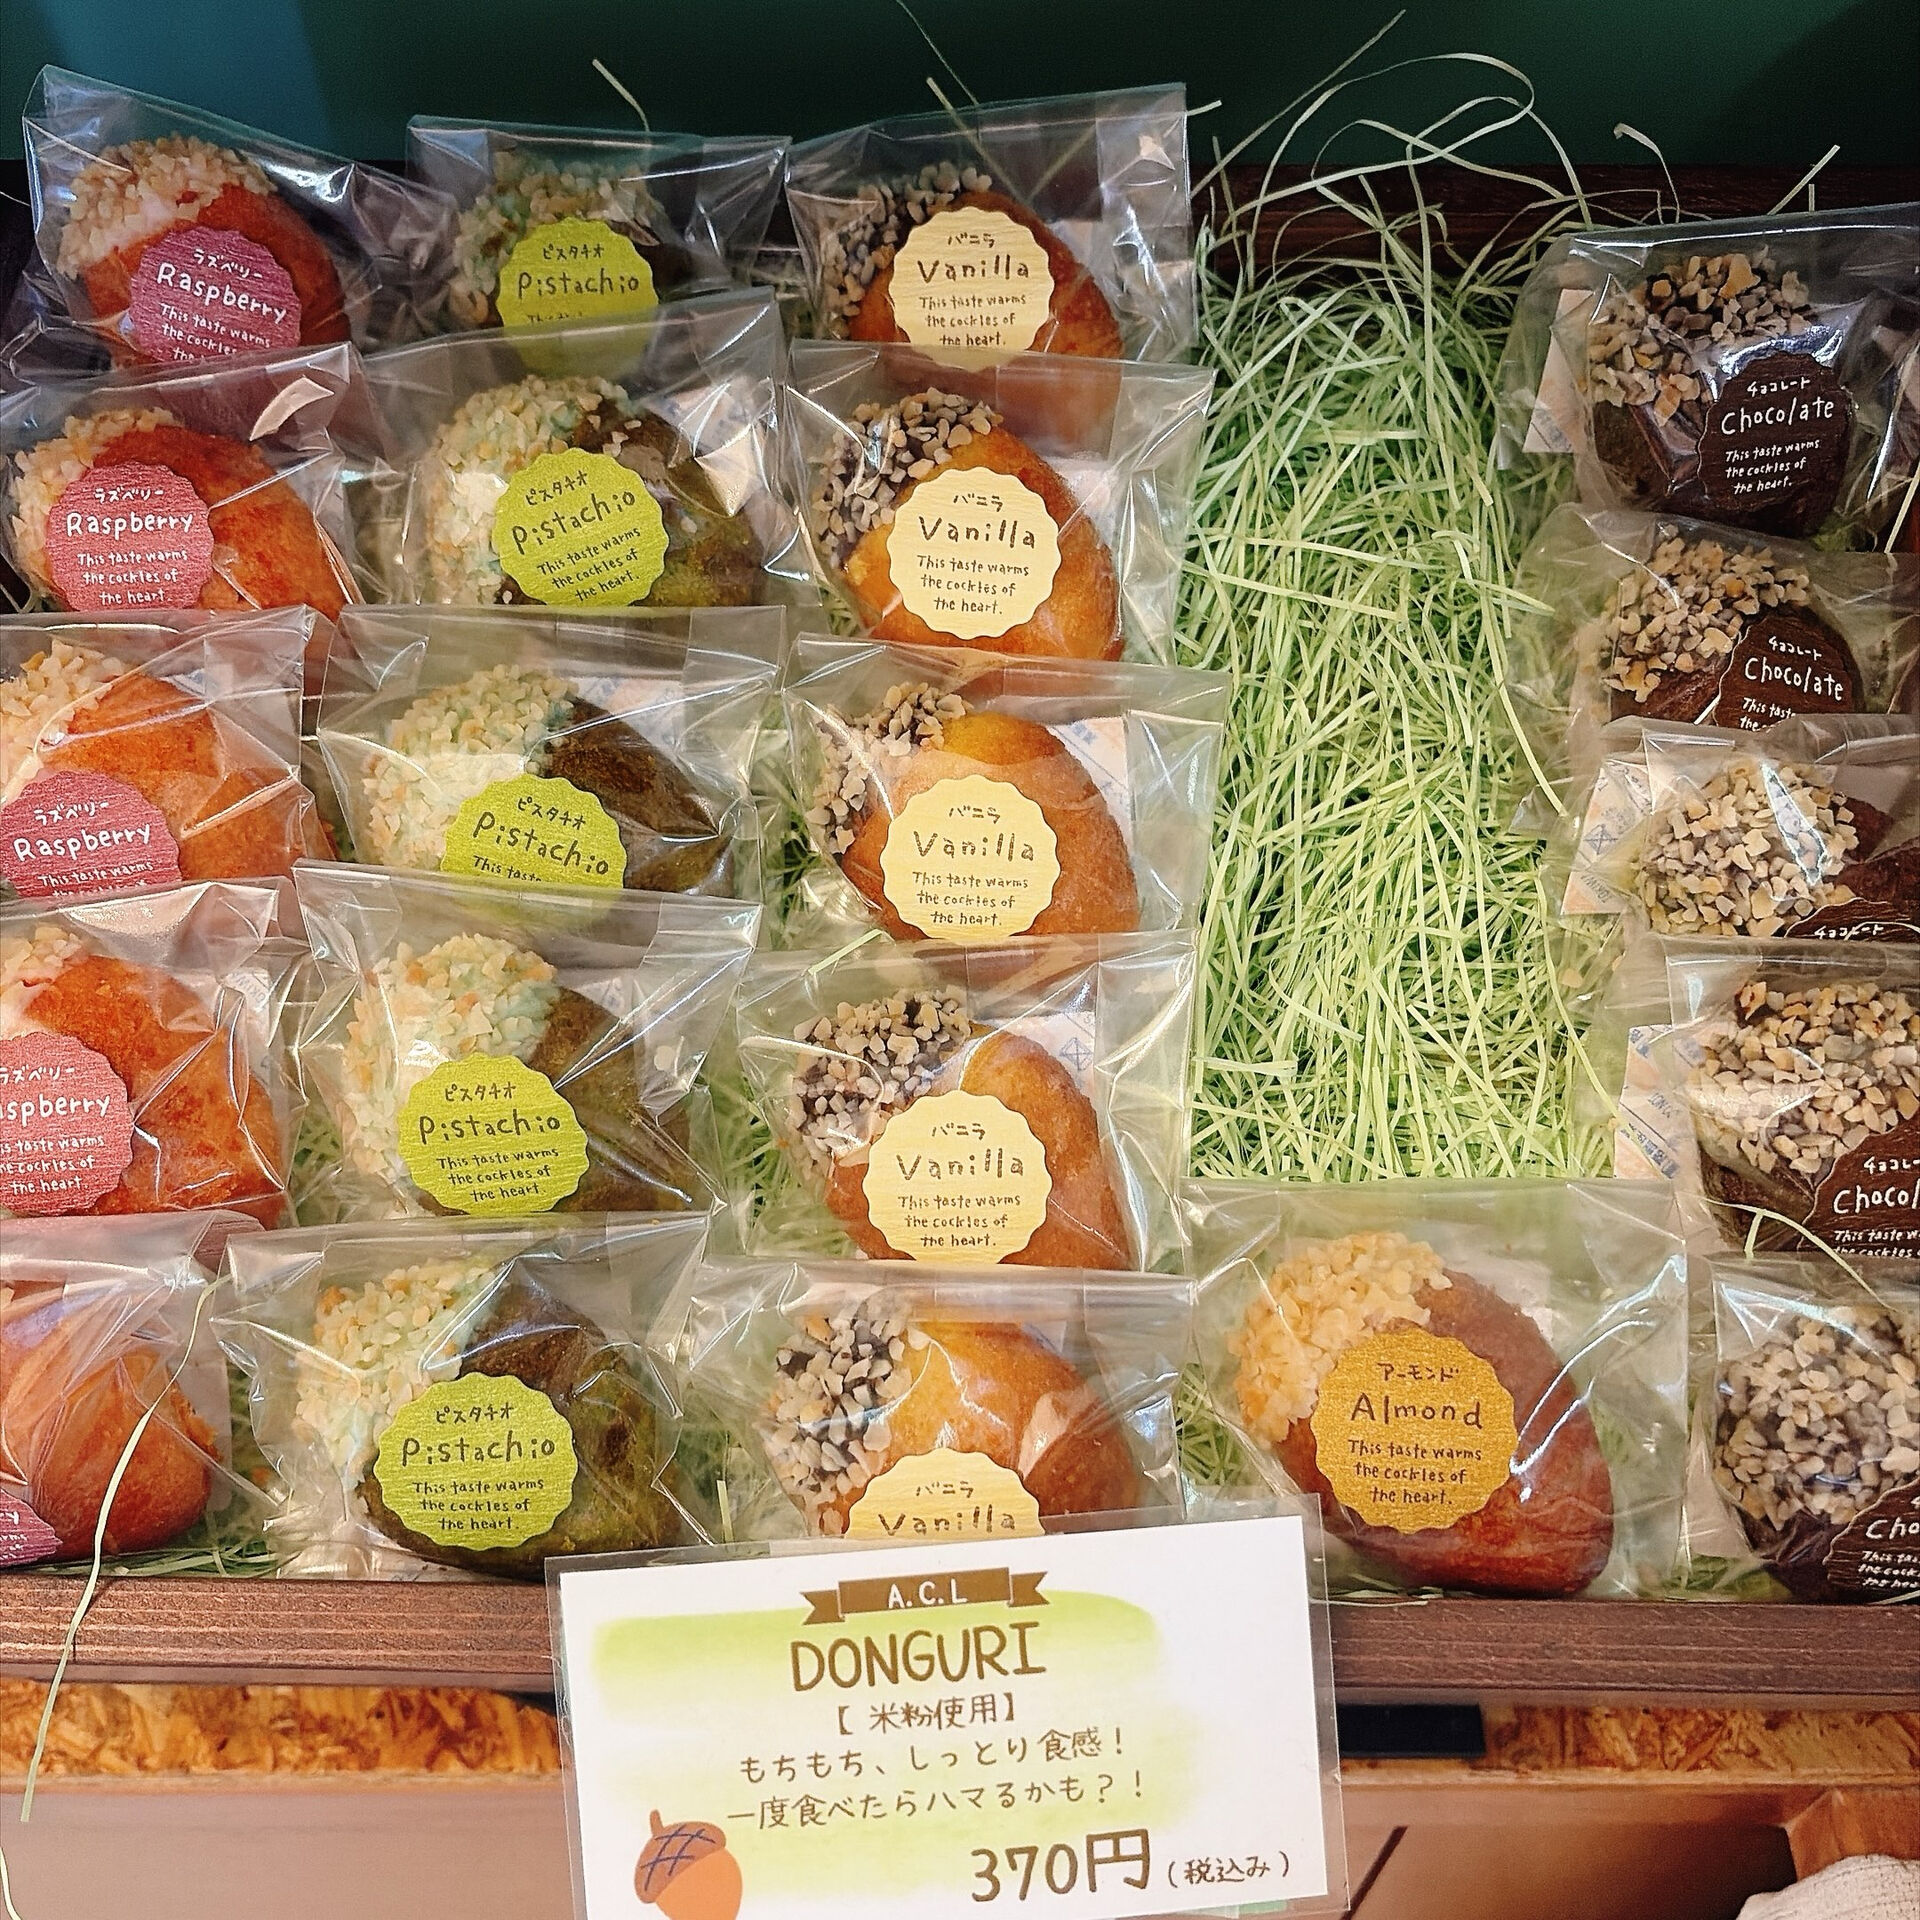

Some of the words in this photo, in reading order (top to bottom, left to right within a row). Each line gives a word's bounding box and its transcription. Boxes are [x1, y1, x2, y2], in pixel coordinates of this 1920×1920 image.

[948, 232, 995, 247] バニラ
[543, 243, 604, 260] ピスタチオ
[194, 249, 262, 279] ラズベリー
[917, 254, 1028, 283] Vanilla
[157, 263, 286, 324] Raspberry
[919, 296, 946, 310] This
[951, 296, 982, 308] taste
[987, 295, 1026, 305] warms
[160, 302, 188, 323] This
[192, 314, 226, 335] taste
[231, 328, 270, 348] warms
[926, 315, 945, 327] the
[950, 314, 998, 326] cockles
[1003, 313, 1016, 325] of
[162, 324, 184, 340] the
[940, 334, 960, 345] the
[1747, 377, 1811, 397] チョコレート
[1722, 397, 1834, 435] Chocolate
[1725, 452, 1749, 462] This
[1753, 445, 1782, 459] taste
[1785, 440, 1820, 453] warms
[1725, 467, 1744, 478] the
[1747, 461, 1790, 476] cockles
[1794, 457, 1806, 469] of
[94, 486, 164, 504] ラズベリー
[525, 470, 588, 506] ピスタチオ
[1734, 483, 1752, 495] the
[954, 493, 1003, 512] バニラ
[66, 512, 193, 540] Raspberry
[919, 516, 1035, 549] Vanilla
[77, 553, 104, 567] This
[109, 551, 142, 565] taste
[146, 550, 188, 562] warms
[537, 560, 565, 575] This
[567, 545, 599, 565] taste
[602, 528, 641, 550] warms
[552, 575, 574, 589] the
[577, 558, 623, 581] cockles
[626, 548, 638, 561] of
[917, 555, 945, 569] This
[950, 558, 983, 572] taste
[988, 563, 1029, 576] warms
[83, 572, 104, 584] the
[109, 570, 160, 584] cockles
[164, 568, 178, 583] of
[921, 574, 941, 589] the
[947, 580, 997, 594] cockles
[1002, 583, 1016, 596] of
[100, 592, 122, 605] the
[575, 586, 596, 601] the
[934, 597, 955, 610] the
[1768, 636, 1822, 661] チョコレート
[1745, 657, 1843, 701] Chocolate
[1743, 697, 1766, 713] This
[1740, 716, 1759, 731] the
[34, 801, 109, 825] ラズベリー
[517, 797, 586, 830] ピスタチオ
[949, 806, 1000, 824] バニラ
[14, 824, 150, 861] Raspberry
[914, 831, 1034, 861] Vanilla
[473, 855, 501, 872] This
[38, 875, 69, 887] This
[72, 869, 107, 884] taste
[110, 861, 153, 878] warms
[913, 872, 942, 886] This
[947, 873, 981, 887] taste
[986, 878, 1028, 888] warms
[917, 890, 939, 905] the
[1001, 895, 1015, 908] of
[931, 911, 953, 923] the
[445, 1082, 516, 1101] ピスタチオ
[0, 1094, 110, 1127] spberry
[932, 1122, 985, 1140] バニラ
[16, 1139, 53, 1153] taste
[58, 1136, 104, 1149] warms
[80, 1155, 95, 1168] of
[437, 1157, 468, 1170] This
[472, 1153, 508, 1166] taste
[514, 1148, 559, 1160] warms
[896, 1148, 1023, 1180] Vanilla
[449, 1173, 472, 1185] the
[477, 1169, 532, 1183] cockles
[537, 1165, 550, 1176] of
[10, 1179, 35, 1194] the
[470, 1190, 495, 1202] the
[898, 1196, 929, 1210] This
[934, 1195, 970, 1209] taste
[976, 1195, 1021, 1207] warms
[905, 1215, 928, 1228] the
[933, 1216, 988, 1228] cockles
[994, 1214, 1008, 1228] of
[921, 1237, 944, 1247] the
[1834, 1230, 1862, 1242] This
[1868, 1229, 1902, 1242] taste
[1377, 1363, 1459, 1381] アーモンド
[436, 1402, 514, 1424] ピスタチオ
[1351, 1392, 1482, 1429] Almond
[1348, 1439, 1382, 1456] This
[1388, 1442, 1427, 1458] taste
[1433, 1448, 1481, 1460] warms
[1354, 1462, 1379, 1478] the
[1384, 1468, 1444, 1482] cockles
[1451, 1469, 1467, 1484] of
[412, 1482, 445, 1495] This
[452, 1481, 490, 1494] taste
[496, 1479, 544, 1490] warms
[916, 1481, 974, 1498] バニラ
[1371, 1487, 1395, 1501] the
[1403, 1489, 1453, 1505] heart.
[420, 1499, 444, 1510] the
[451, 1500, 508, 1512] cockles
[515, 1499, 530, 1510] of
[438, 1518, 464, 1530] the
[471, 1517, 519, 1530] heart.
[878, 1504, 1015, 1536] Vanilla
[888, 1579, 967, 1609] A.C.L
[791, 1621, 1046, 1691] DONGURI
[971, 1829, 1149, 1902] 370円
